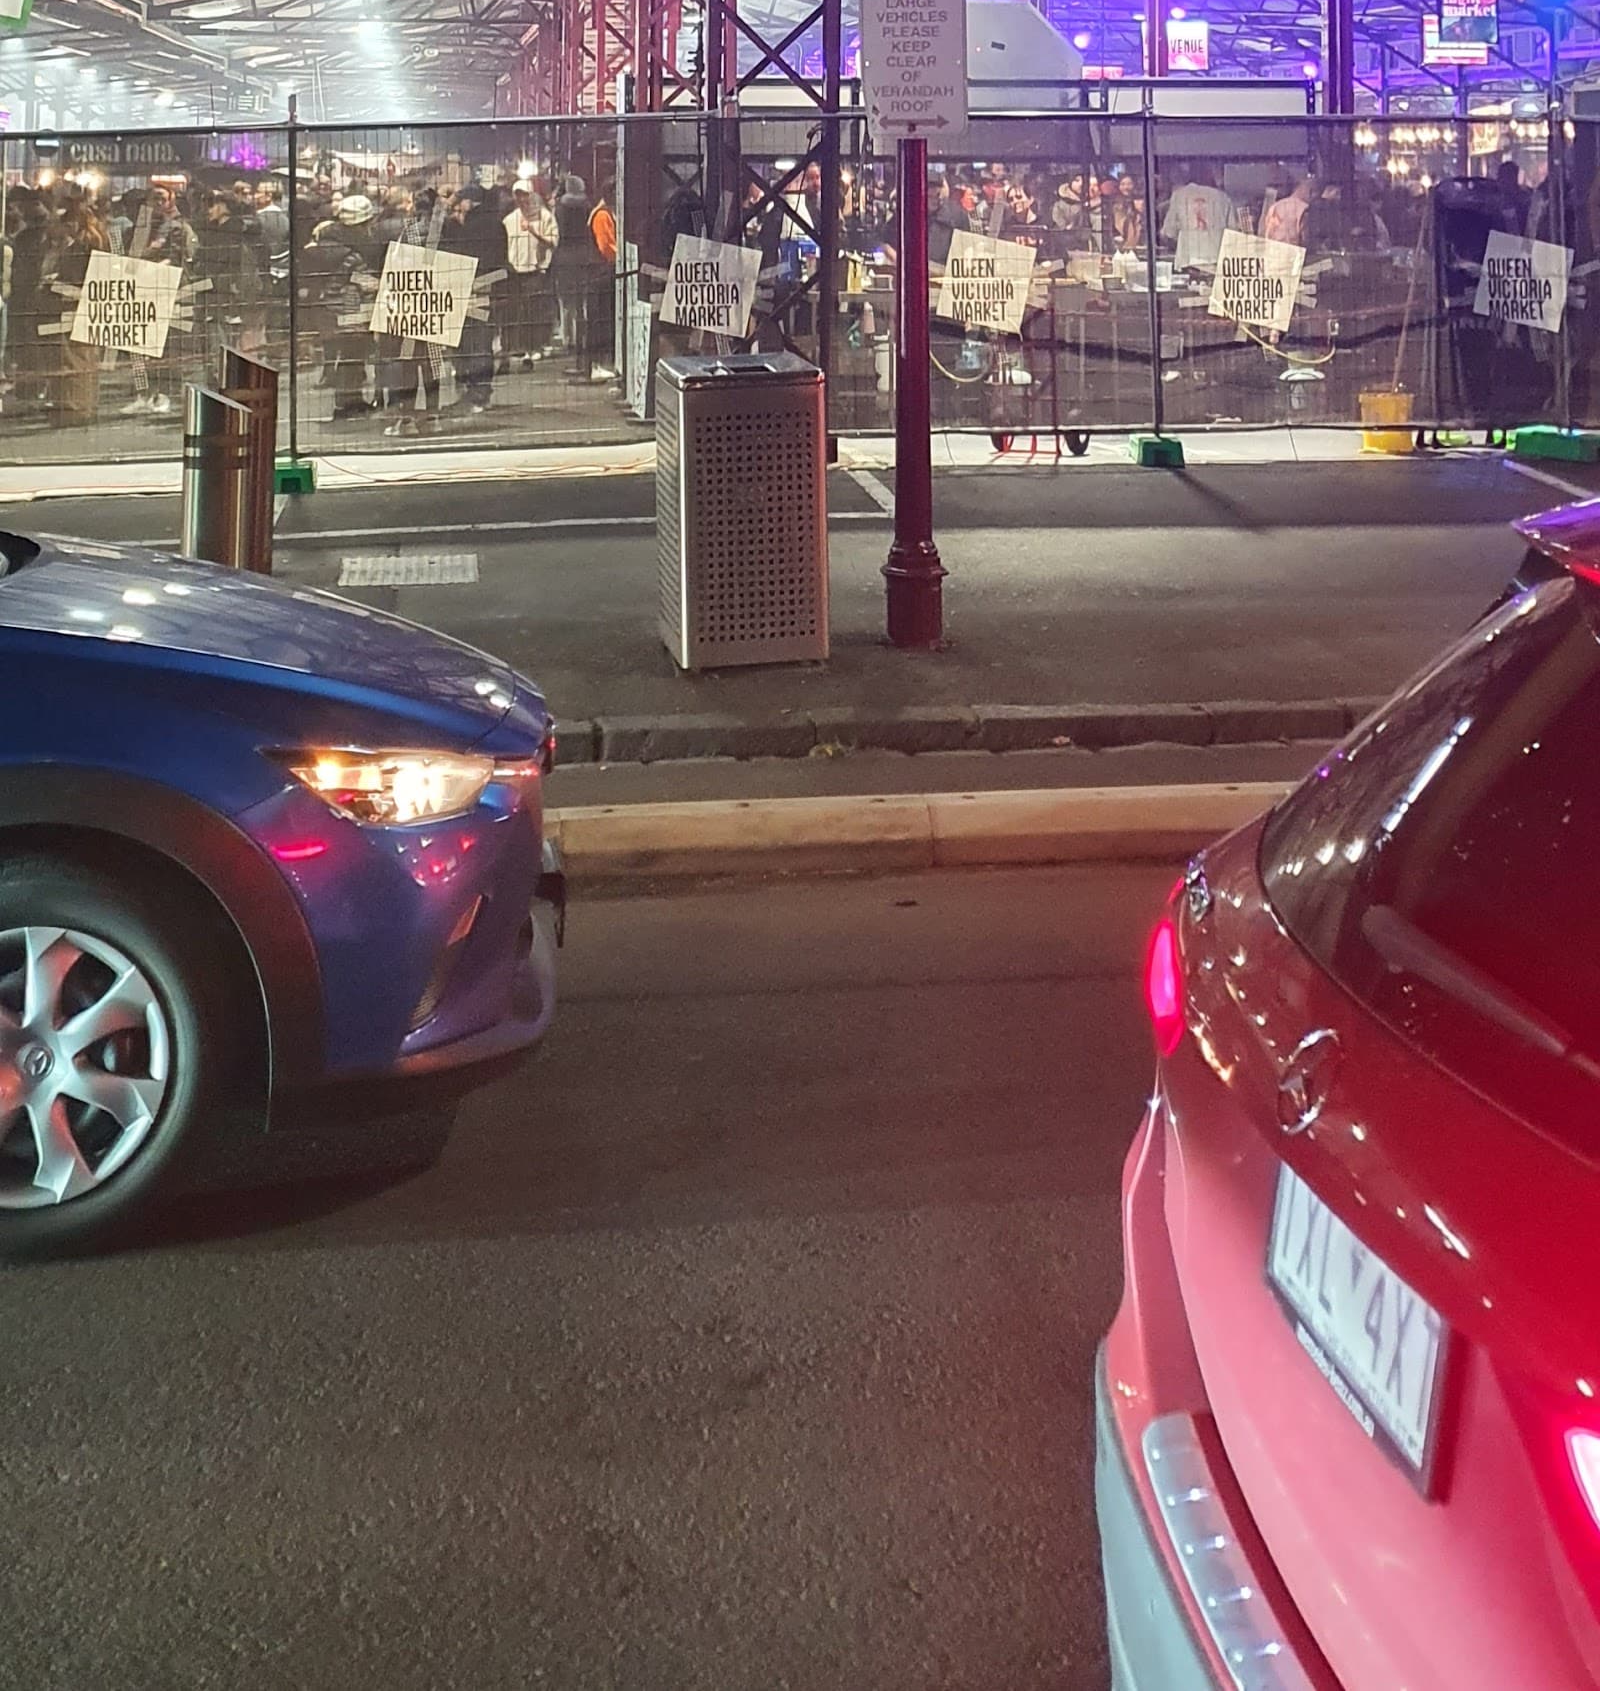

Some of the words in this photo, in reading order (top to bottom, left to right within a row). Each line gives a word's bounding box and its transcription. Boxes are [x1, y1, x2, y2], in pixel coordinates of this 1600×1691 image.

[876, 10, 948, 23] VEHICLES
[1442, 4, 1496, 17] market
[882, 25, 940, 38] PLEASE
[891, 40, 931, 53] KEEP
[1170, 38, 1204, 53] VENUE
[885, 55, 937, 68] CLEAR
[901, 70, 921, 82] OF
[872, 85, 954, 98] VERANDAH
[891, 100, 933, 112] ROOF
[675, 262, 720, 283] QUEEN
[951, 258, 995, 278] QUEEN
[1222, 257, 1264, 277] QUEEN
[1488, 257, 1532, 278] QUEEN
[87, 279, 136, 302] QUEEN
[386, 270, 433, 292] QUEEN
[951, 279, 1014, 300] VICTORIA
[1222, 278, 1283, 299] VICTORIA
[1488, 279, 1552, 299] VICTORIA
[675, 284, 739, 305] VICTORIA
[88, 301, 156, 324] VICTORIA
[675, 305, 732, 326] MARKET
[952, 301, 1007, 321] MARKET
[1223, 299, 1276, 320] MARKET
[1489, 299, 1545, 320] MARKET
[88, 324, 148, 346] MARKET
[386, 314, 445, 336] MARKET
